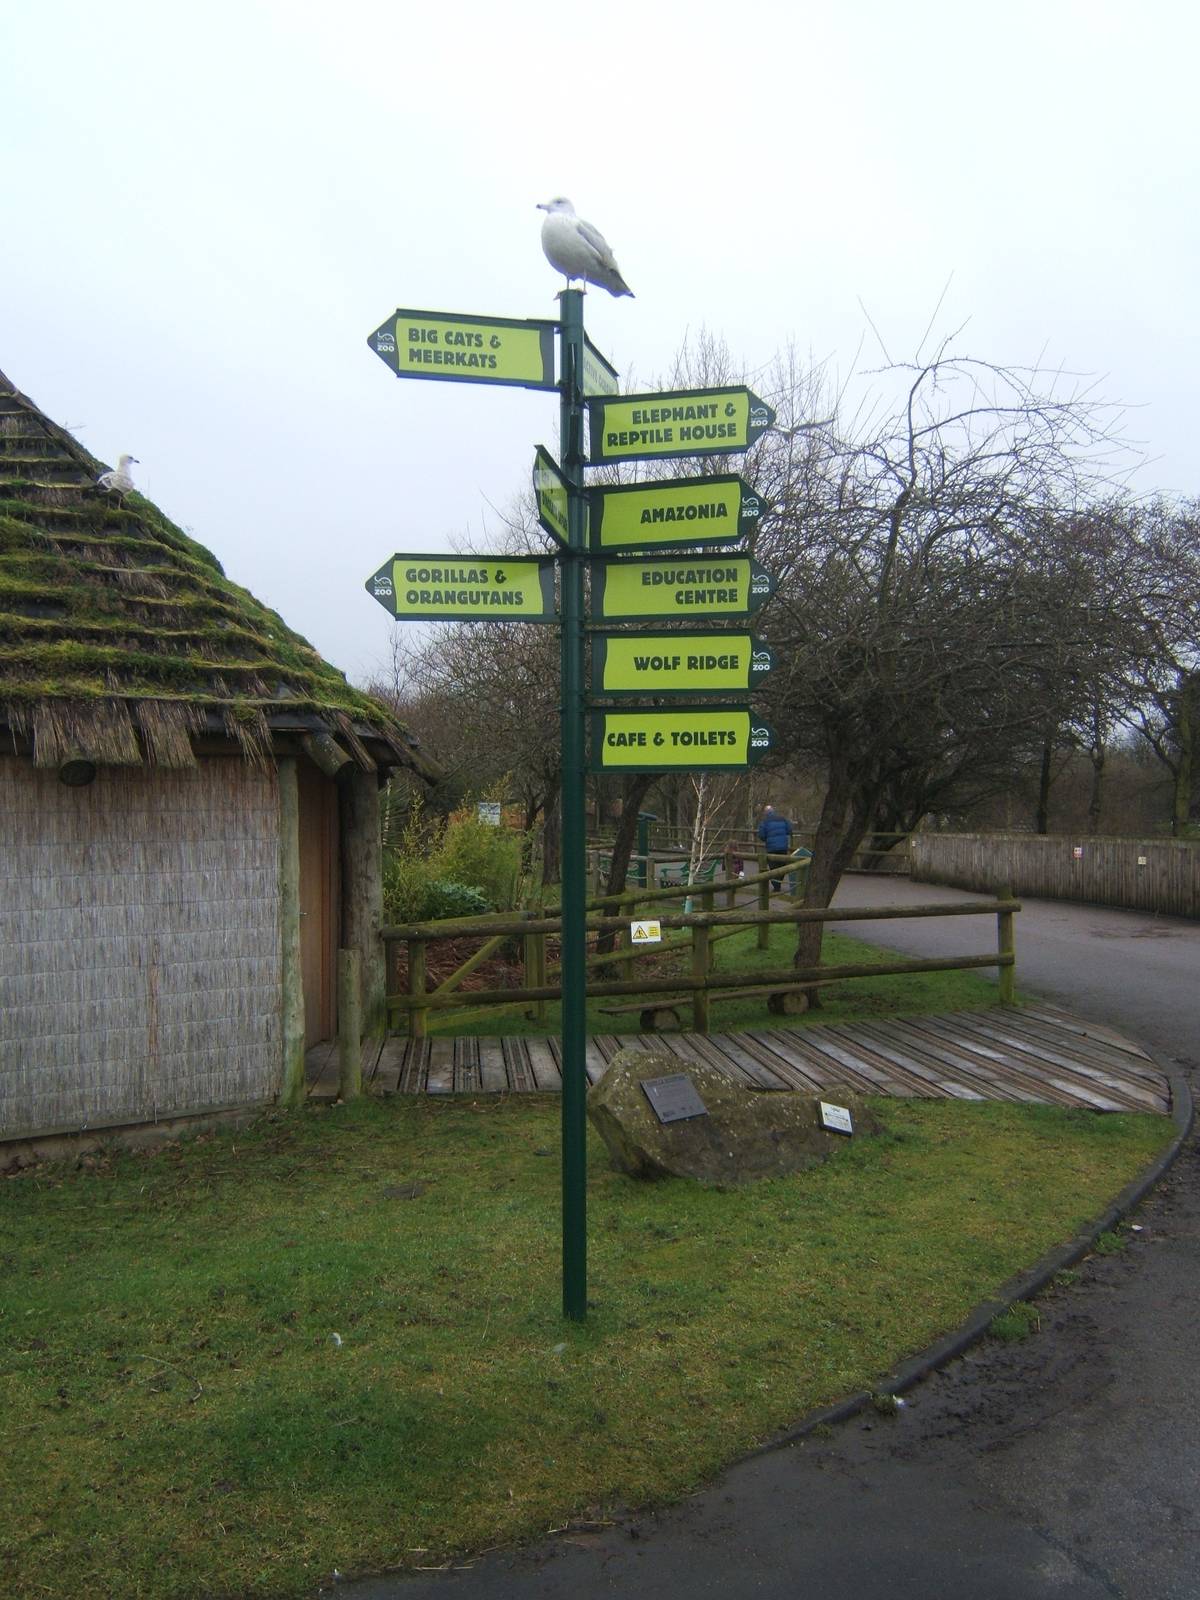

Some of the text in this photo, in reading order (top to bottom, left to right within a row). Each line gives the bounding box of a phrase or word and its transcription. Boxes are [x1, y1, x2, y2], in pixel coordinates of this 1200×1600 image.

[408, 327, 501, 348] BIG CATS &
[376, 344, 395, 352] ZOO
[408, 348, 497, 368] MEERKATS
[632, 402, 737, 424] ELEPHANT &
[750, 419, 768, 427] ZOO
[607, 423, 736, 447] REPTILE HOUSE
[640, 502, 728, 524] AMAZONIA
[742, 509, 759, 517] ZOO
[405, 568, 507, 583] GORILLAS &
[641, 568, 737, 586] EDUCATION
[374, 588, 392, 596] ZOO
[405, 590, 524, 606] ORANGUTANS
[675, 588, 737, 604] CENTRE
[634, 655, 739, 670] WOLF RIDGE
[607, 731, 737, 747] CAFE & TOILETS
